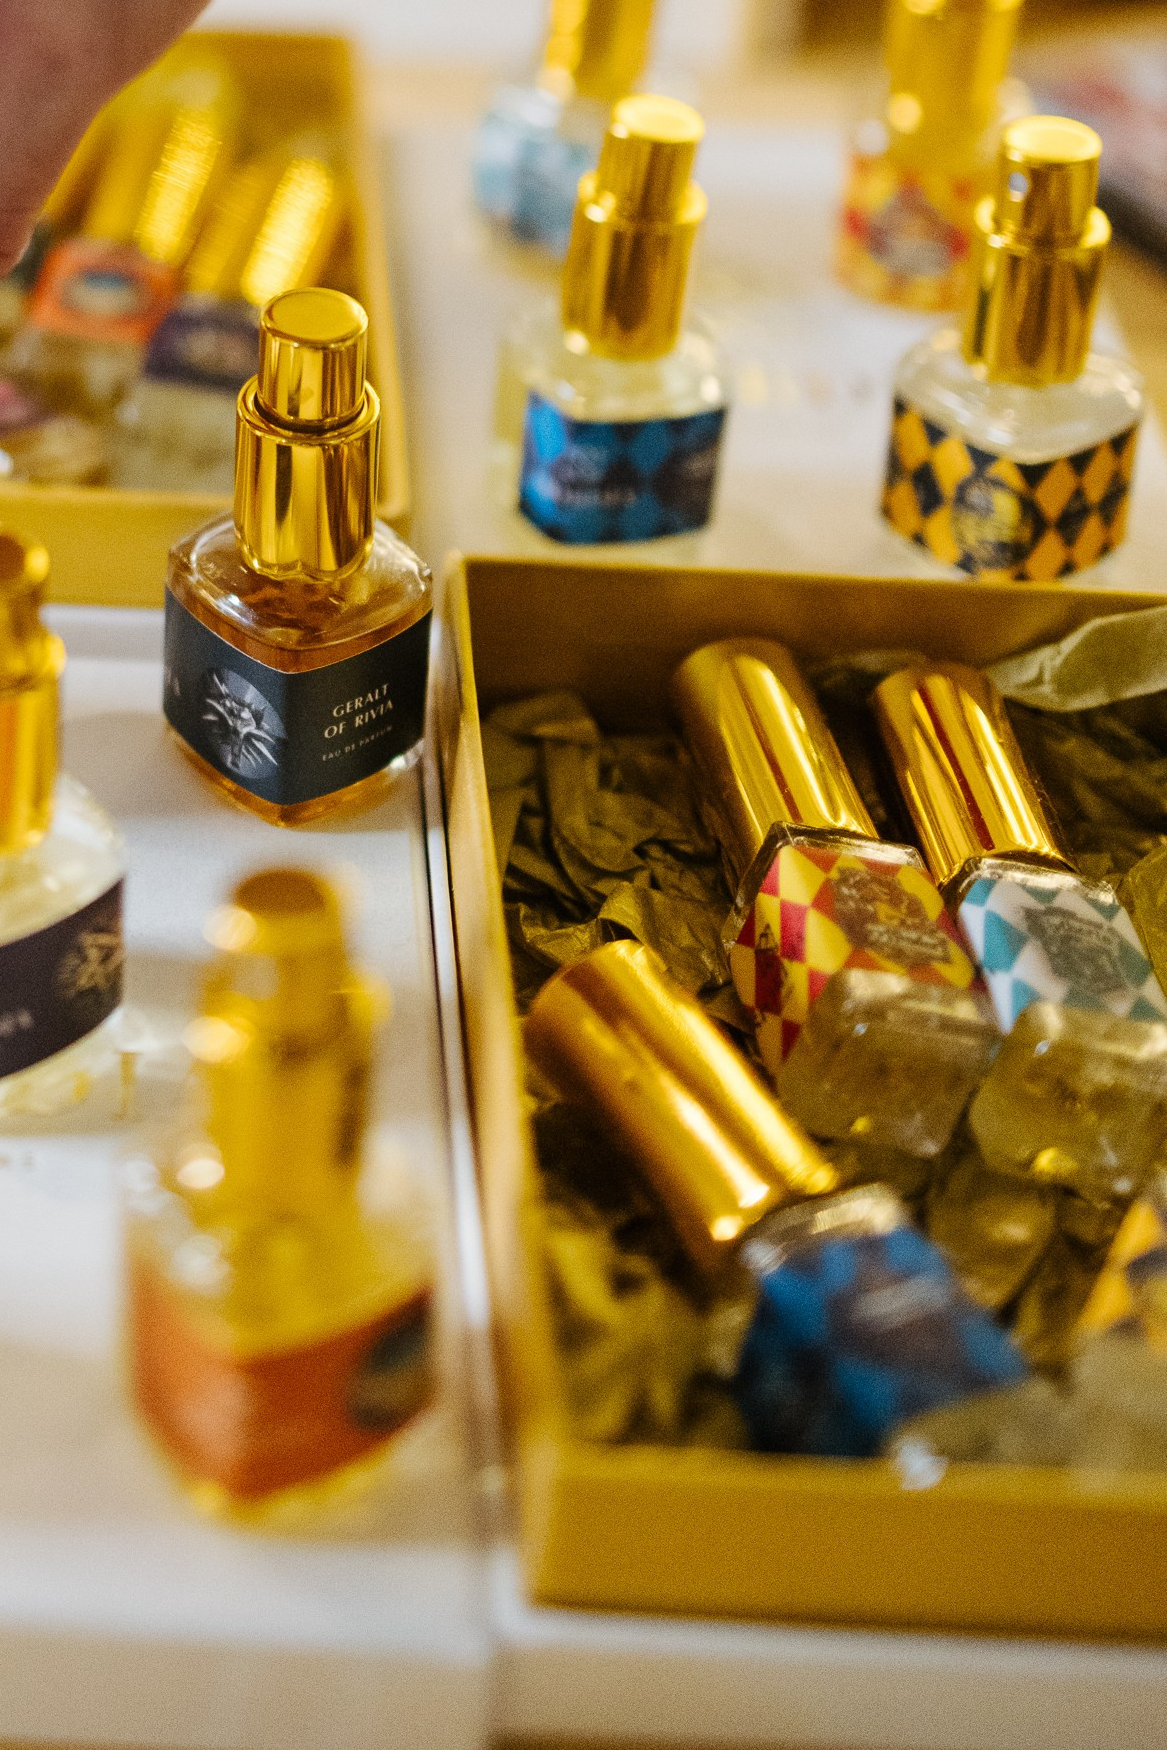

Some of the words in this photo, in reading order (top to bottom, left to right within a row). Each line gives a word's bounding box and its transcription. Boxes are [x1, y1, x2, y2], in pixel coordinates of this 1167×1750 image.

[323, 721, 347, 739] OF
[354, 699, 394, 728] RIVIA
[332, 682, 390, 718] GERALT
